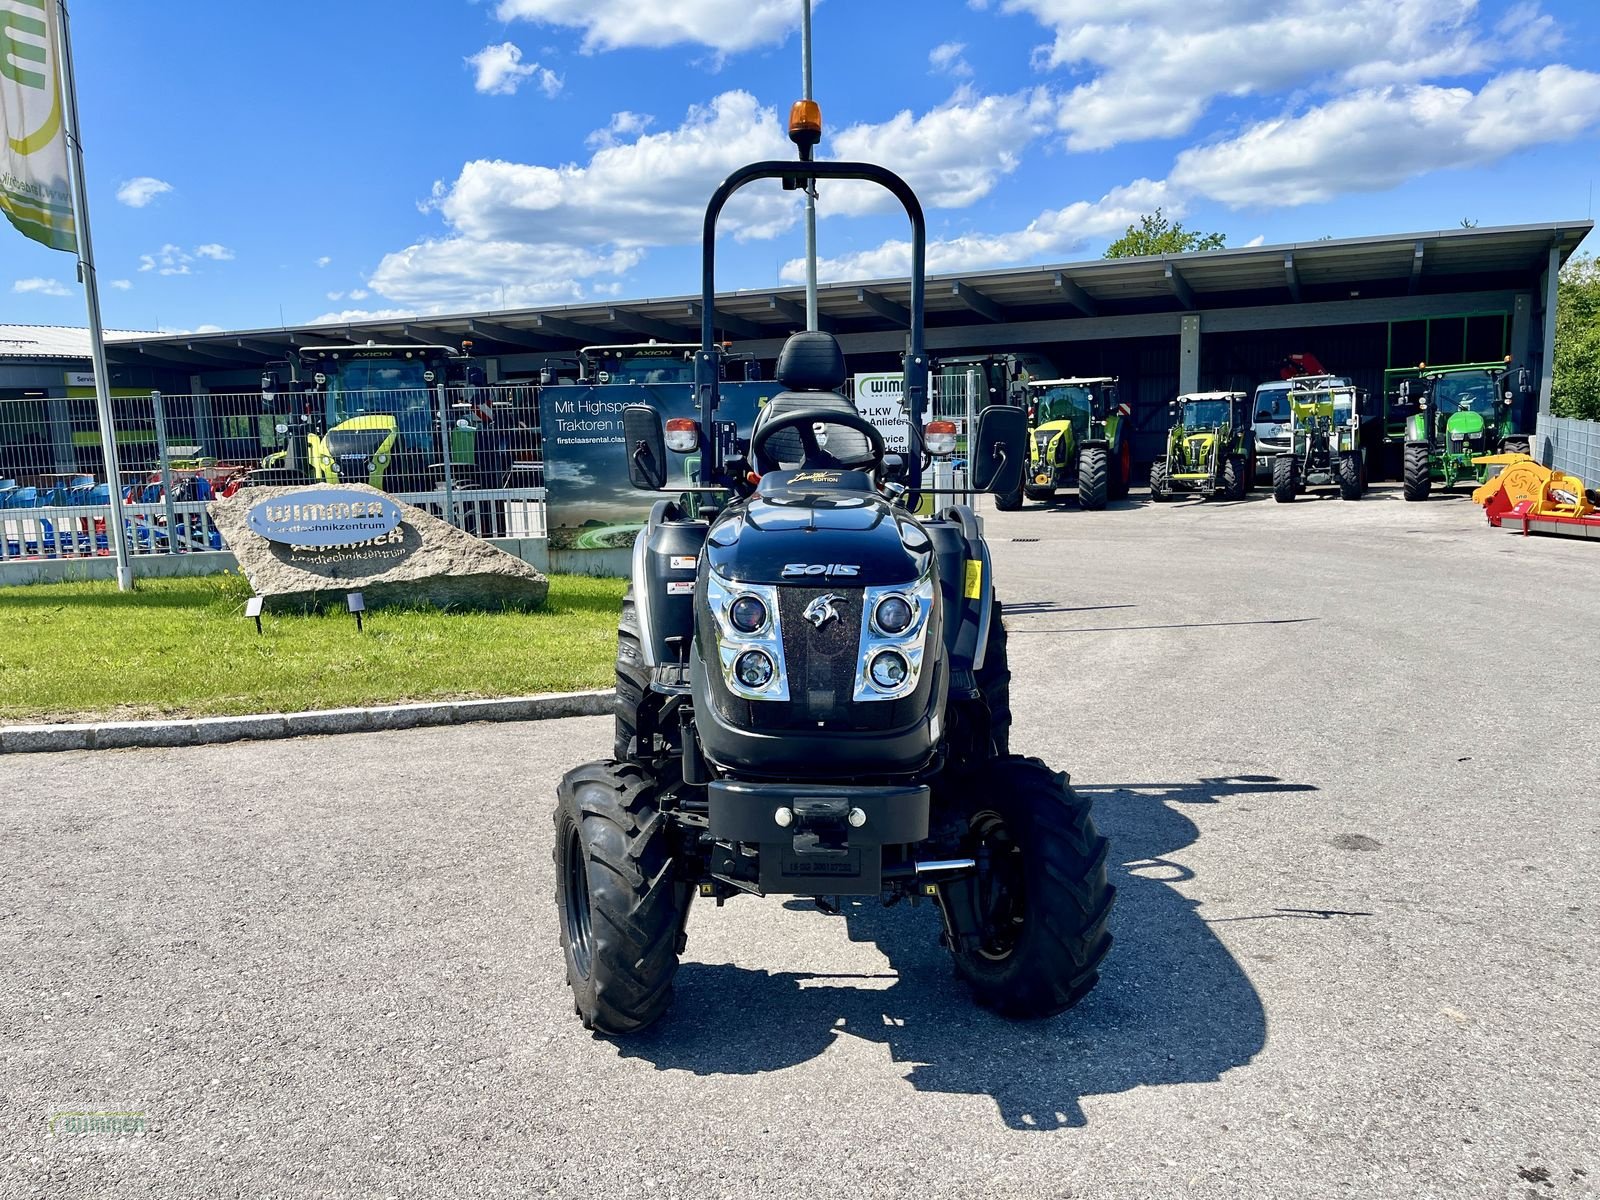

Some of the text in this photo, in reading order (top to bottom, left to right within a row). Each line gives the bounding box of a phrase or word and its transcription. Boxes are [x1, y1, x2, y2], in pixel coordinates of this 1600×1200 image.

[555, 401, 574, 414] Mit
[869, 407, 891, 416] LKW
[555, 419, 612, 431] Traktoren
[557, 436, 626, 444] firstclaasrental.claa
